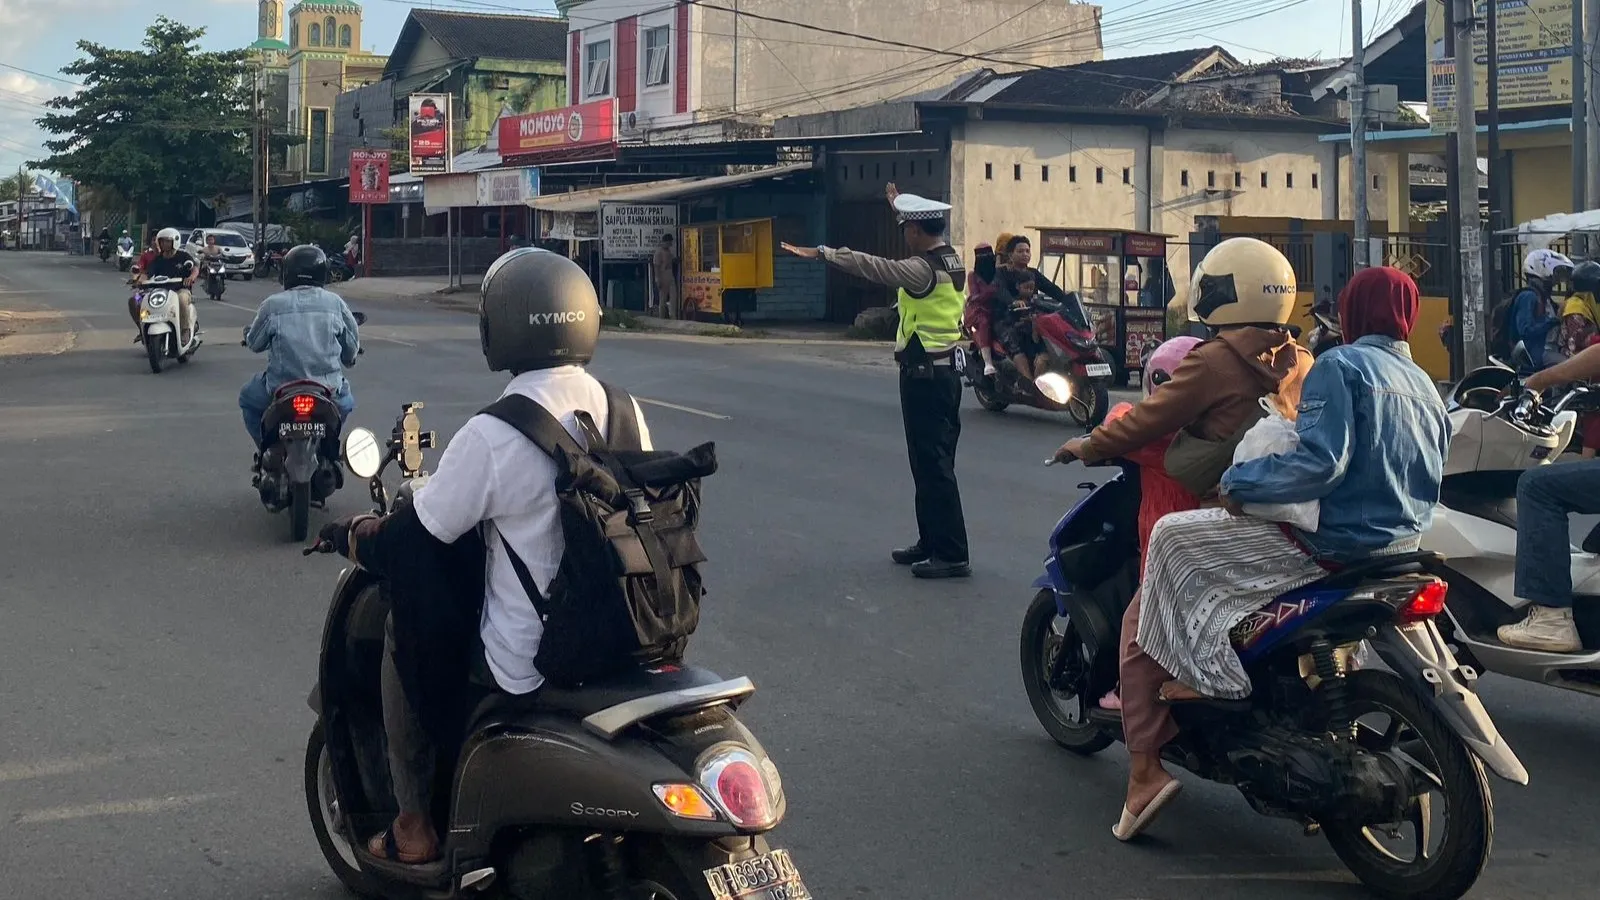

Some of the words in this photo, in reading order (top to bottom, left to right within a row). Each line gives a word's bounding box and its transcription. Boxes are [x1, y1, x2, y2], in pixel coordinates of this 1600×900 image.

[519, 112, 565, 137] MOMOYO
[528, 310, 586, 325] KYMCO
[733, 855, 778, 889] 6953
